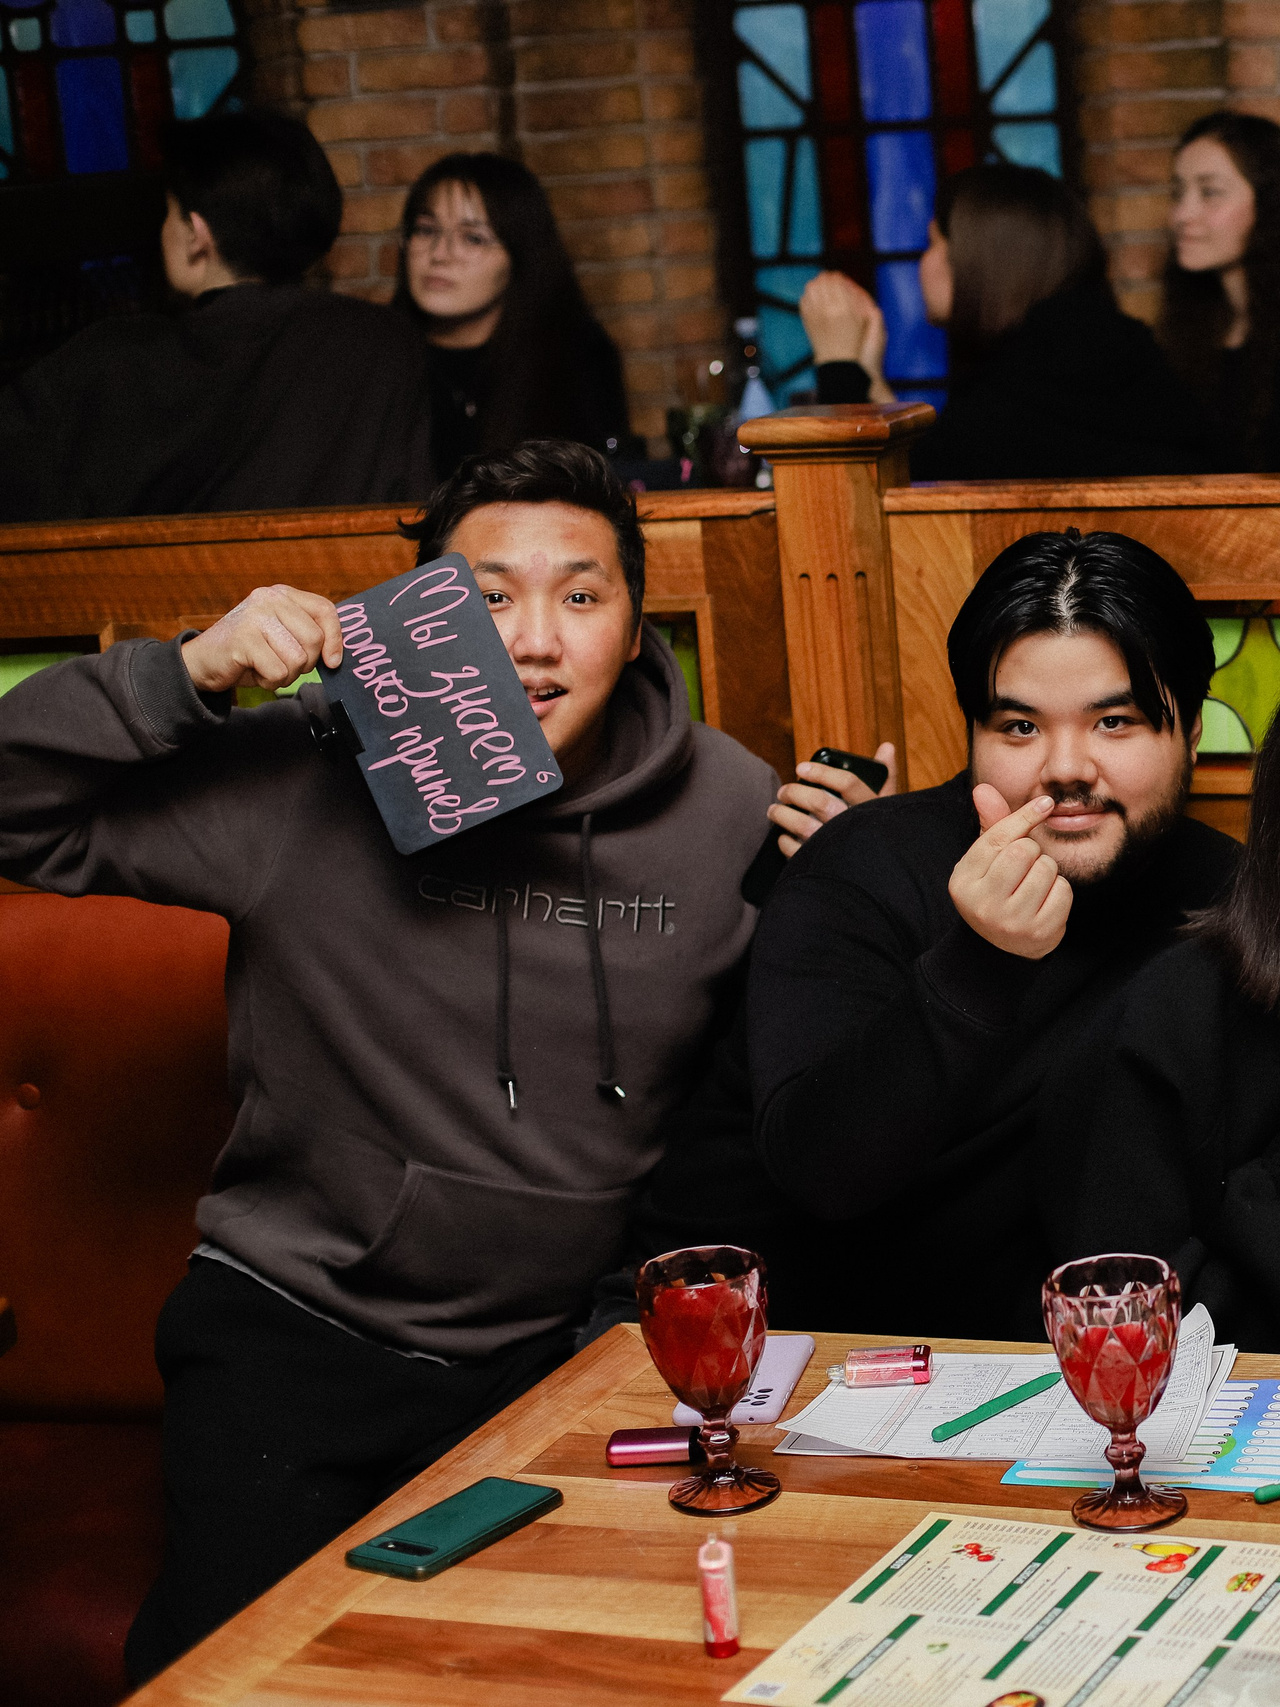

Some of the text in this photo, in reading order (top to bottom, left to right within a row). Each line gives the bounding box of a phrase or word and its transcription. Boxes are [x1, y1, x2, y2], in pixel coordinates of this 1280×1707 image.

[335, 602, 500, 835] только припев
[389, 565, 527, 787] Мы знаем
